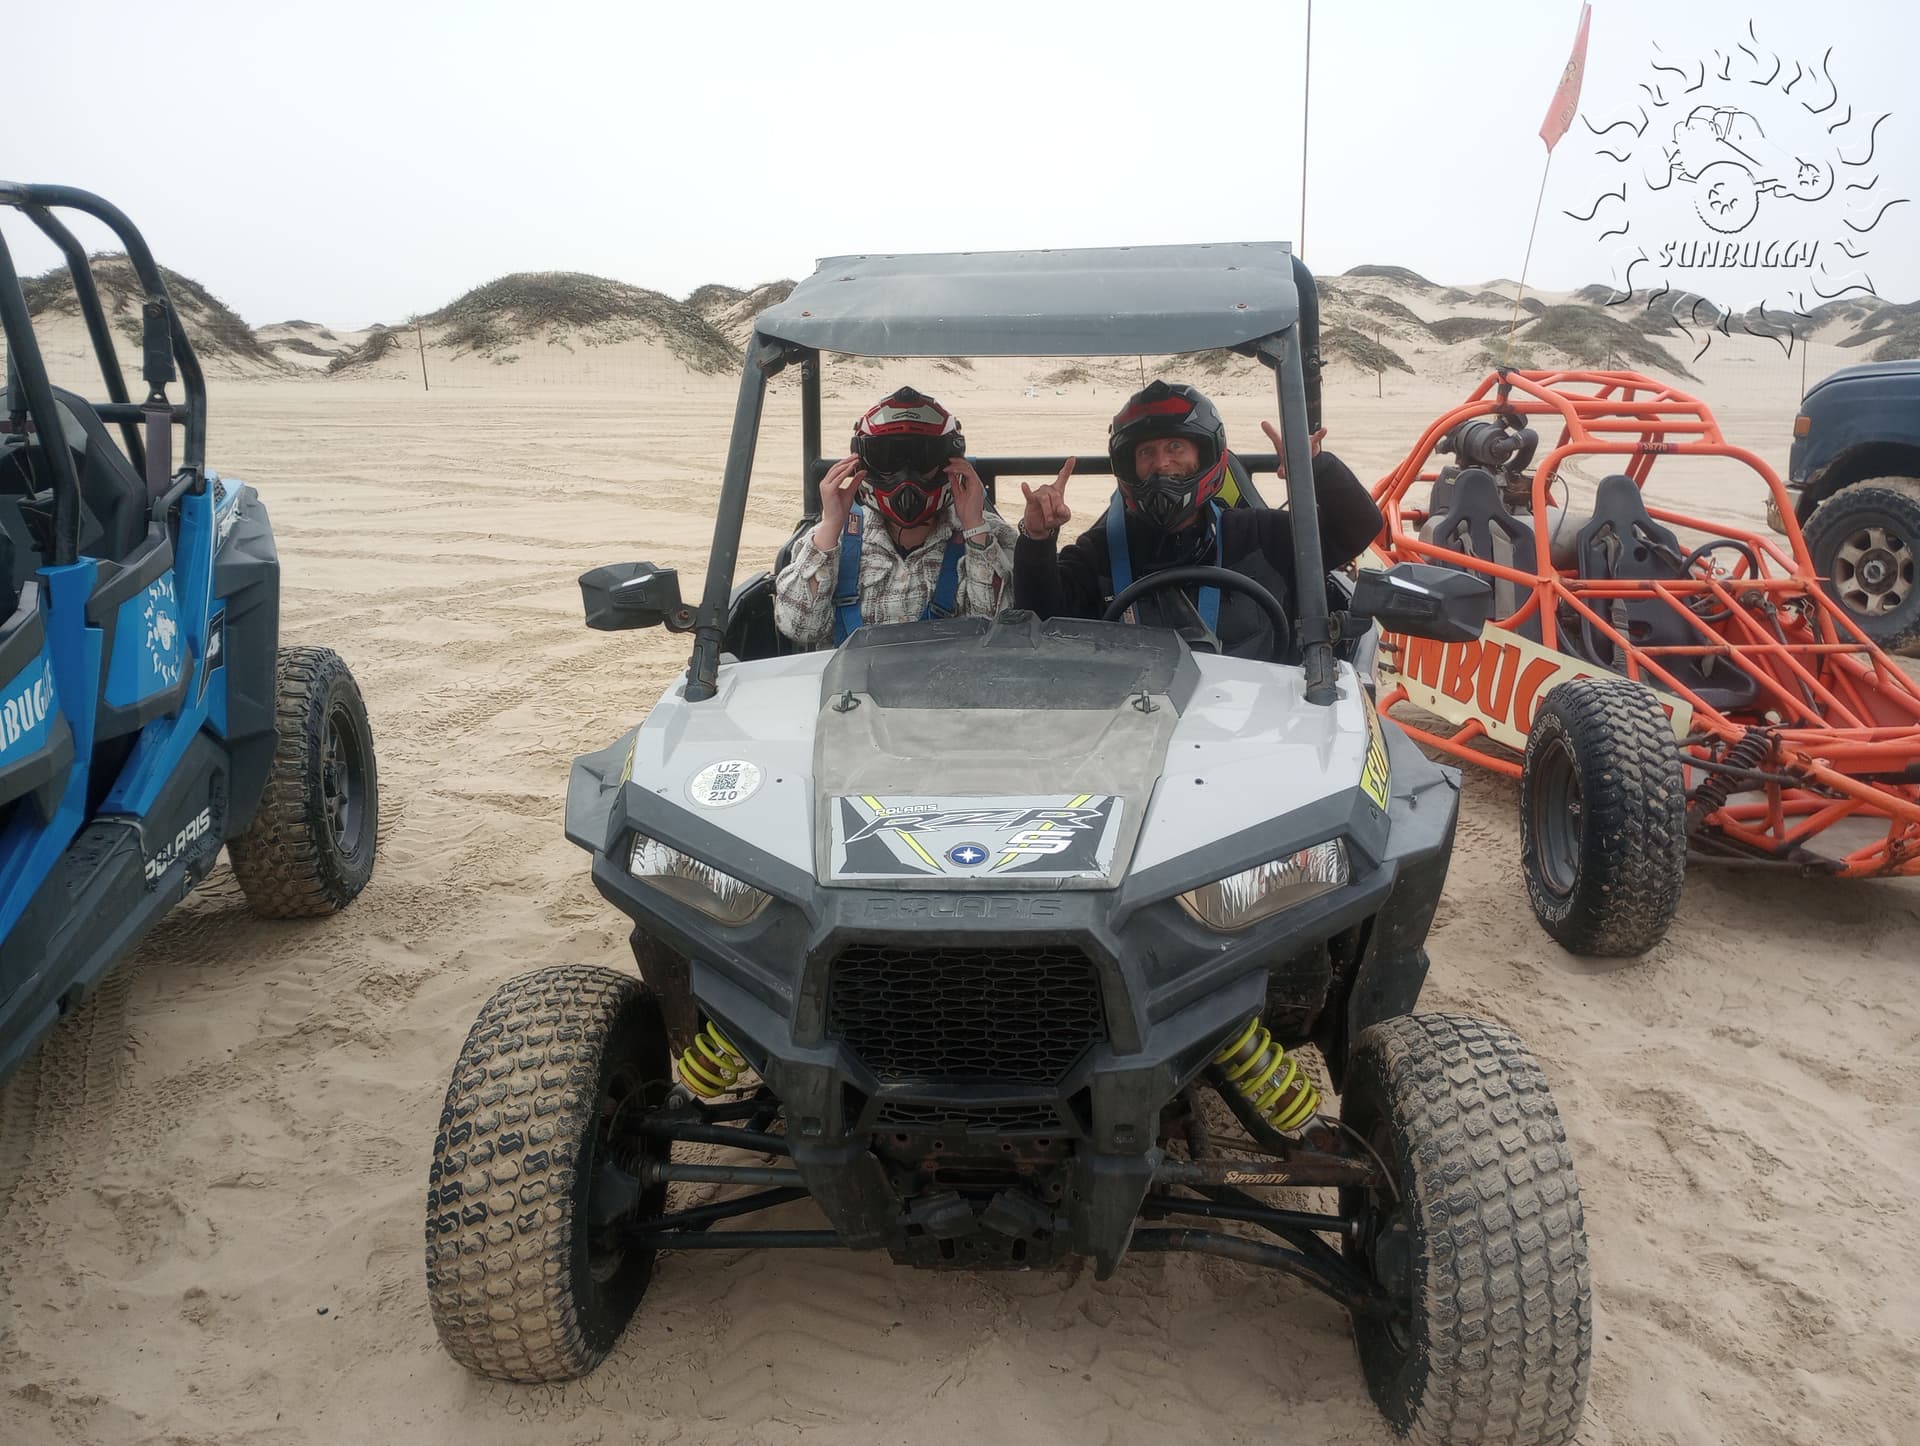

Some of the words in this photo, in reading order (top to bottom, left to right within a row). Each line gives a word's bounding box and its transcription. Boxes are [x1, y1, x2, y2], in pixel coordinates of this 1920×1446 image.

[717, 763, 741, 773] UZ
[708, 790, 738, 801] 210
[875, 803, 938, 816] POLARIS
[841, 807, 1105, 844] RZR
[144, 806, 211, 881] POLARIS
[864, 896, 1063, 919] POLARIS
